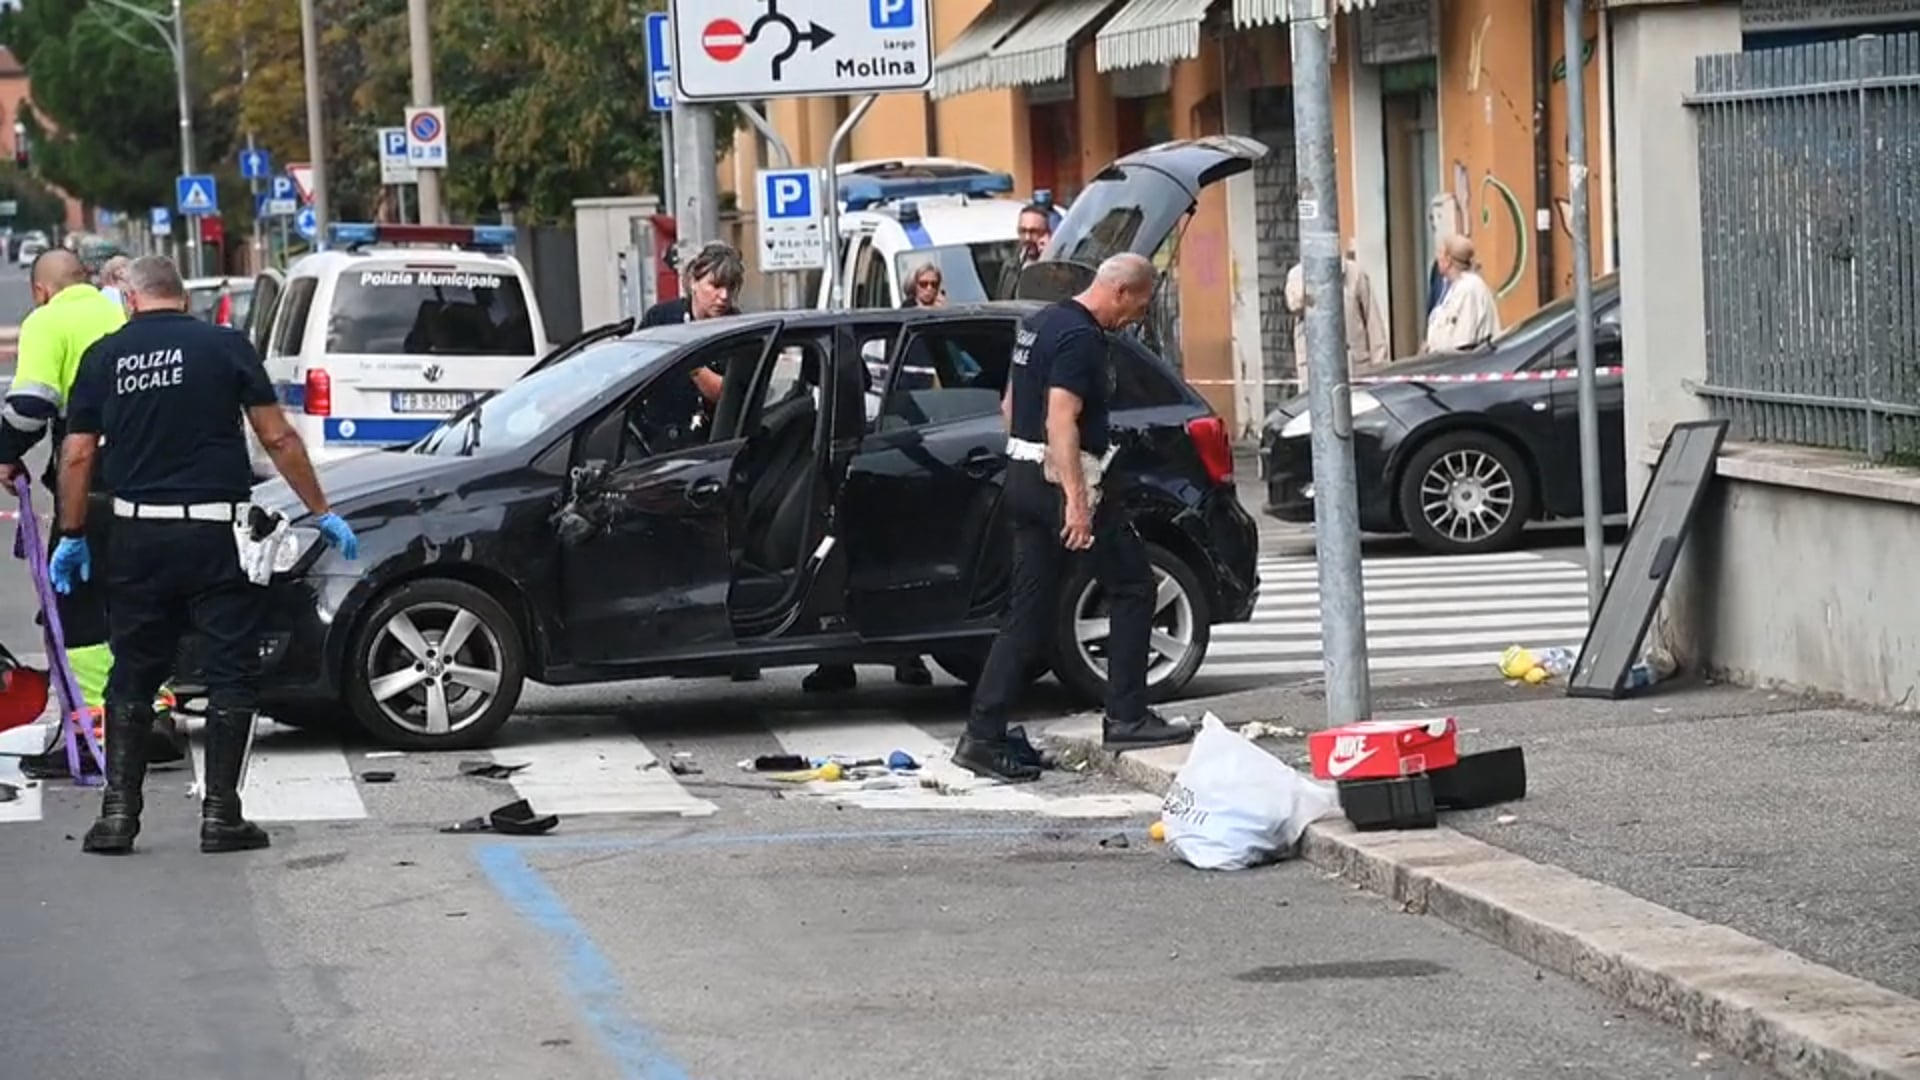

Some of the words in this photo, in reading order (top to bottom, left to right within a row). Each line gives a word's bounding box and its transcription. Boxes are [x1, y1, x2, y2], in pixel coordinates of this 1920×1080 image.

[883, 39, 916, 51] largo
[835, 57, 916, 78] Molina
[775, 178, 802, 214] P
[361, 271, 412, 286] Polizia
[417, 272, 501, 289] Municipale
[115, 347, 183, 375] POLIZIA
[116, 366, 184, 396] LOCALE
[1335, 735, 1367, 758] NIKE
